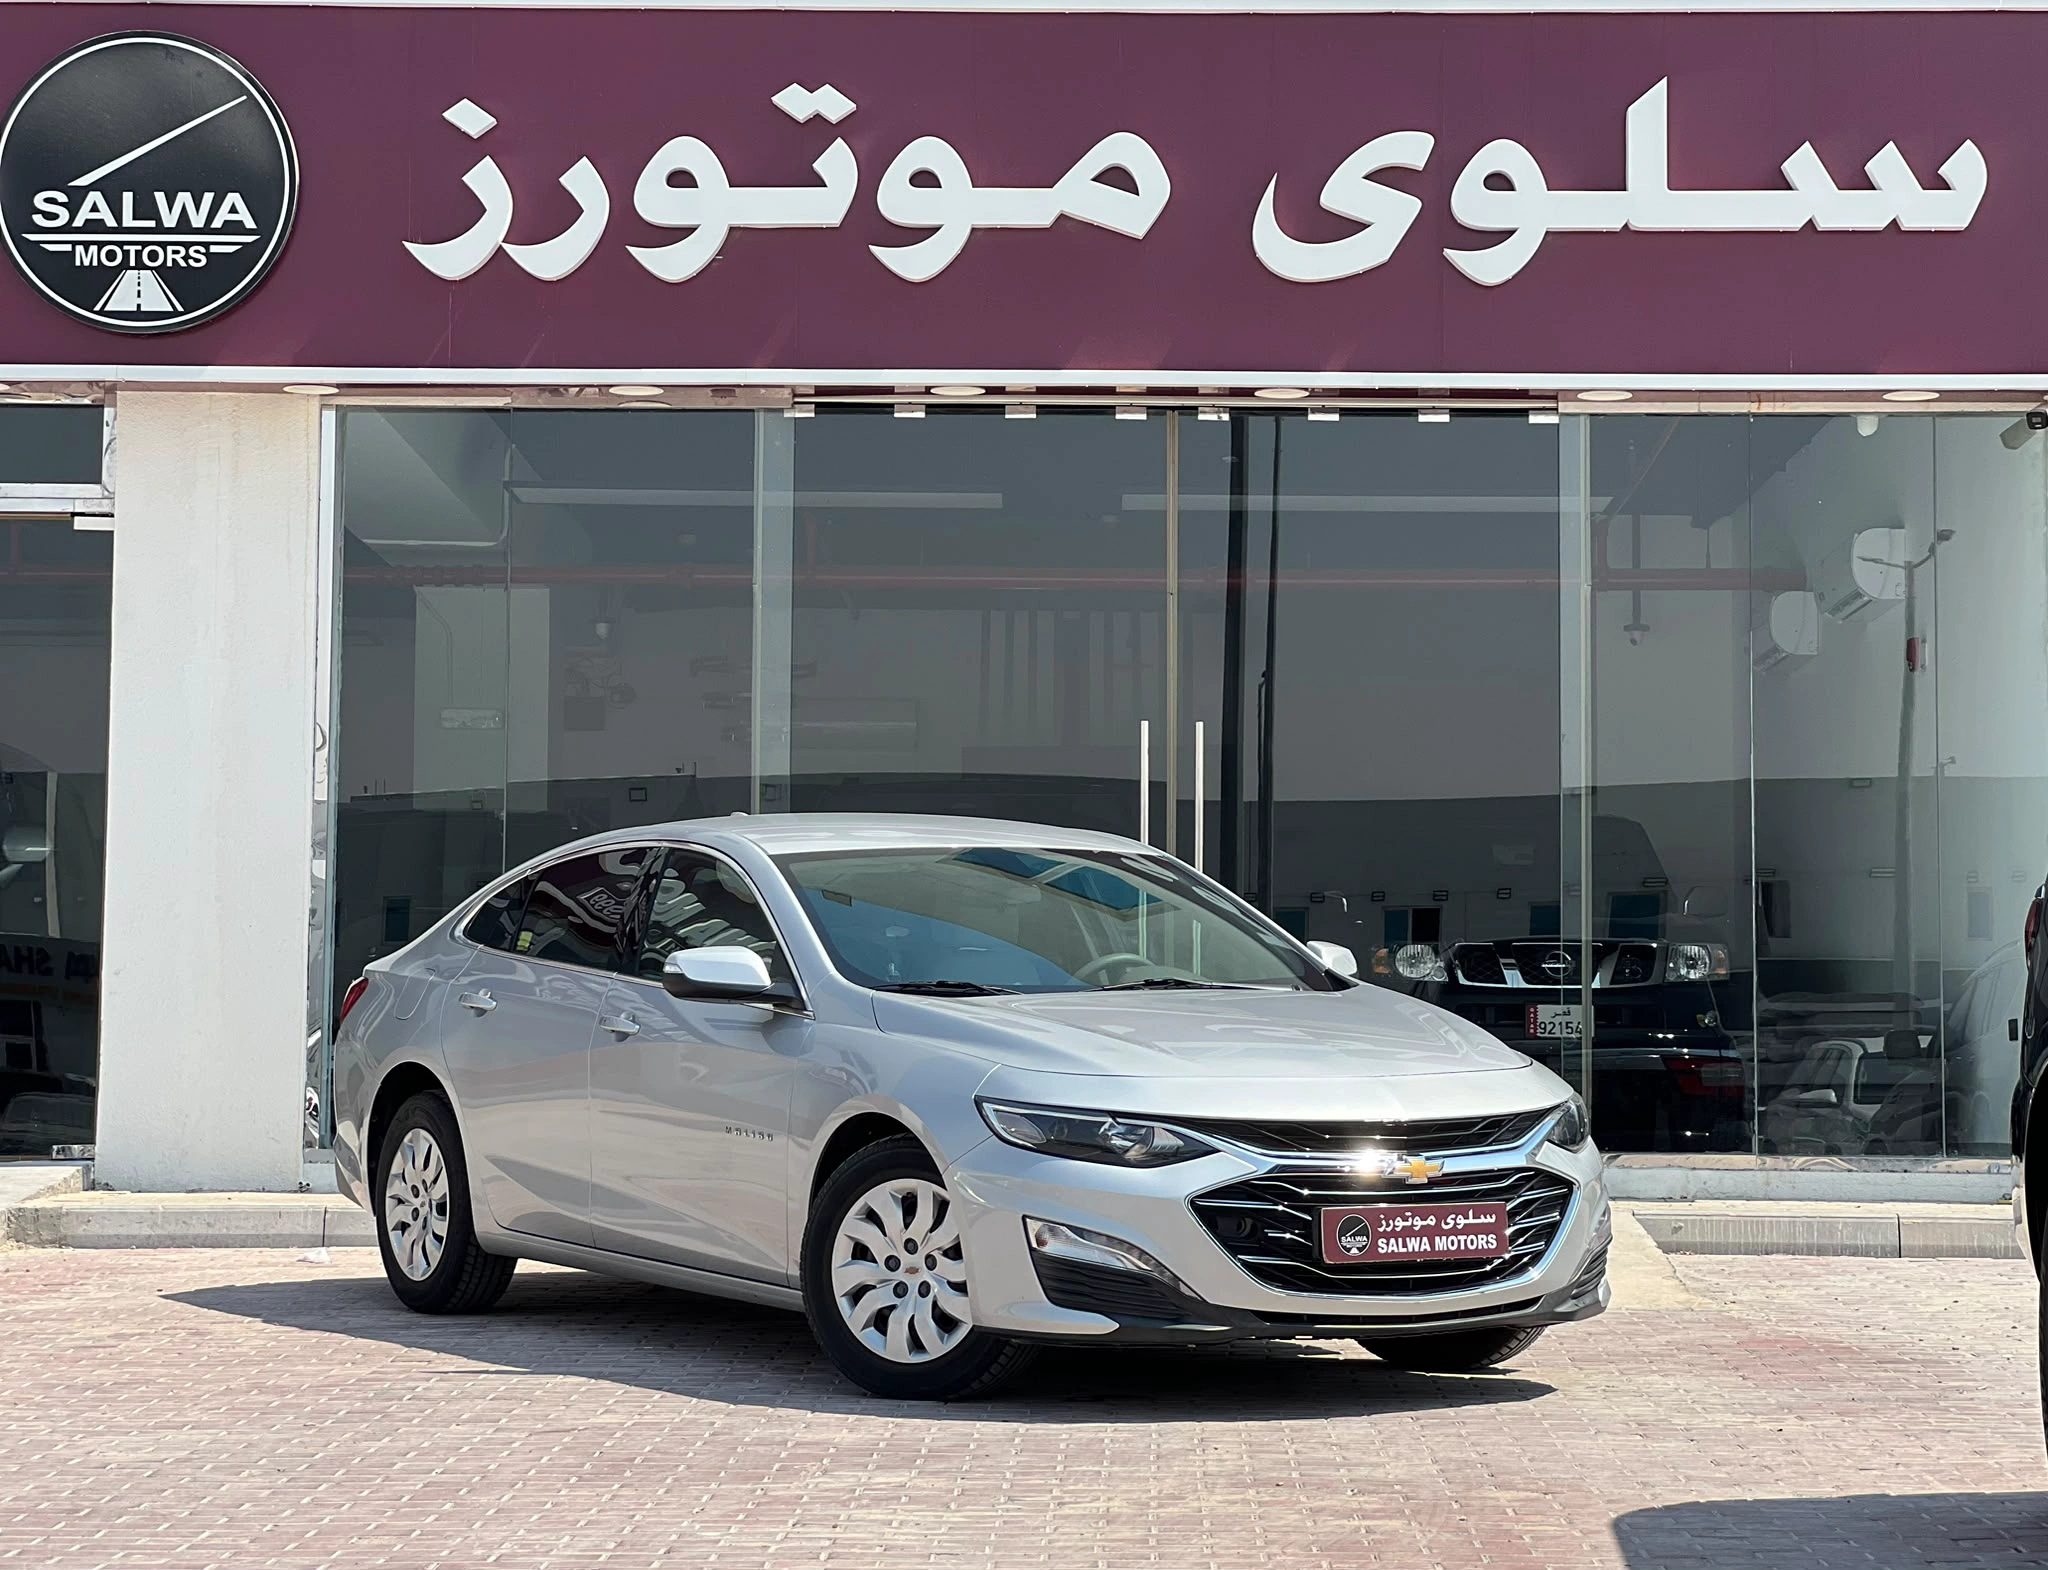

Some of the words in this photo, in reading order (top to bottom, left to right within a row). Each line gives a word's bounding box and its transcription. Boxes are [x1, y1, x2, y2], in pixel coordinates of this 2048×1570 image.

[402, 82, 1171, 283] موتورز
[1252, 75, 1988, 286] سلوى
[32, 190, 257, 229] SALWA
[74, 244, 208, 268] MOTORS
[1377, 1211, 1437, 1232] موتورز
[1441, 1208, 1497, 1230] سلوى
[1340, 1235, 1369, 1244] SALWA
[1377, 1236, 1432, 1254] SALWA
[1435, 1233, 1498, 1252] MOTORS
